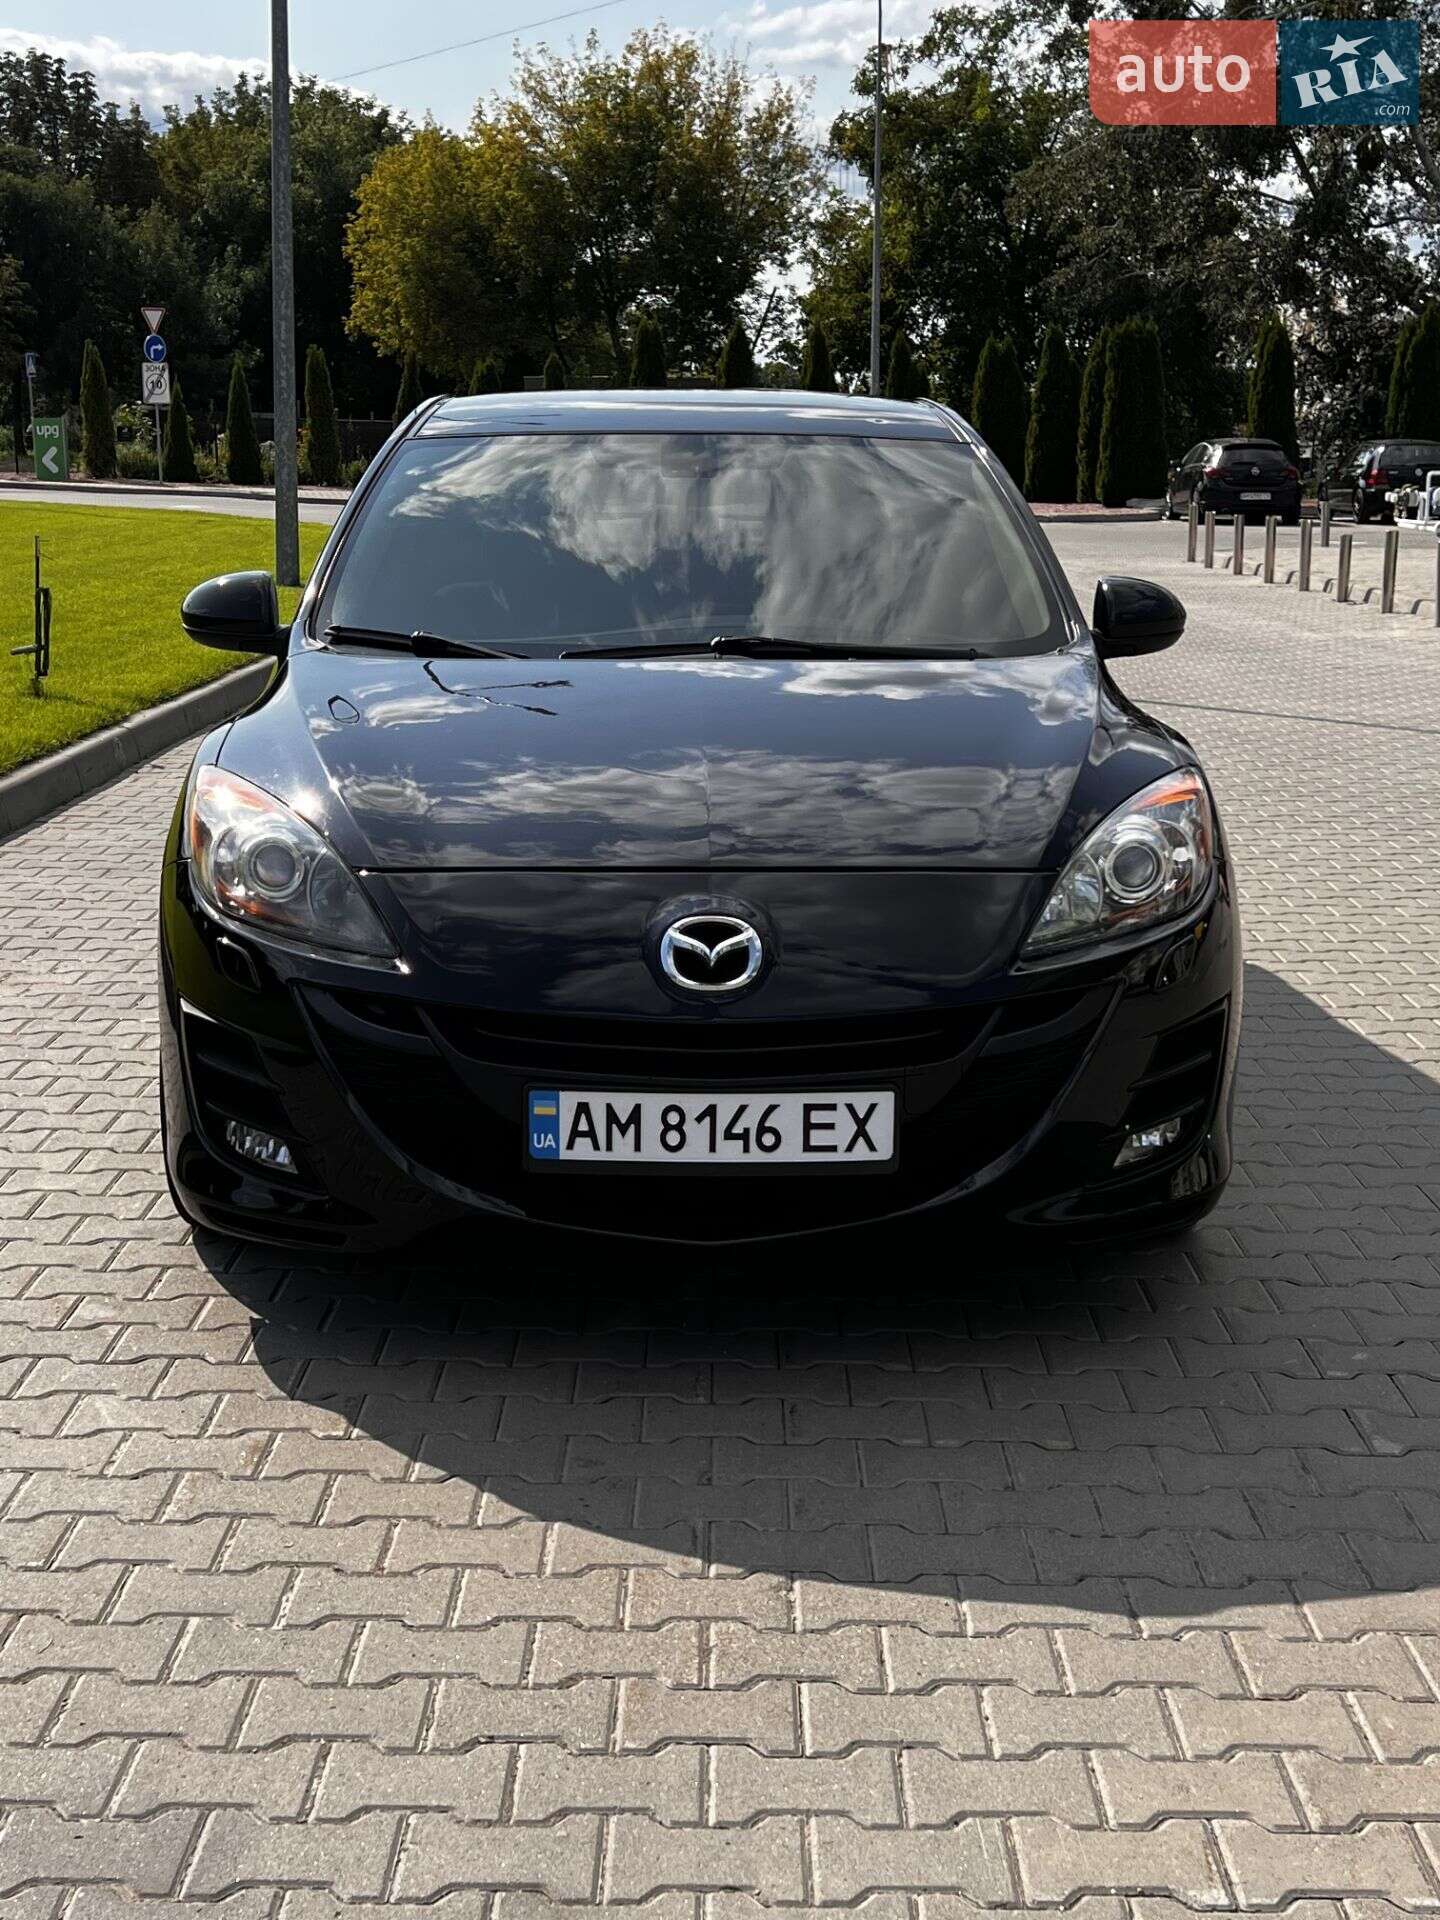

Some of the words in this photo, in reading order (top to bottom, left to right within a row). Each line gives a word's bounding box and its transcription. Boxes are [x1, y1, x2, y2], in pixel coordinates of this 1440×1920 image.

[36, 425, 59, 439] upg
[565, 1101, 642, 1153] AM
[659, 1104, 782, 1154] 8146
[802, 1103, 879, 1153] EX
[533, 1132, 556, 1149] UA
